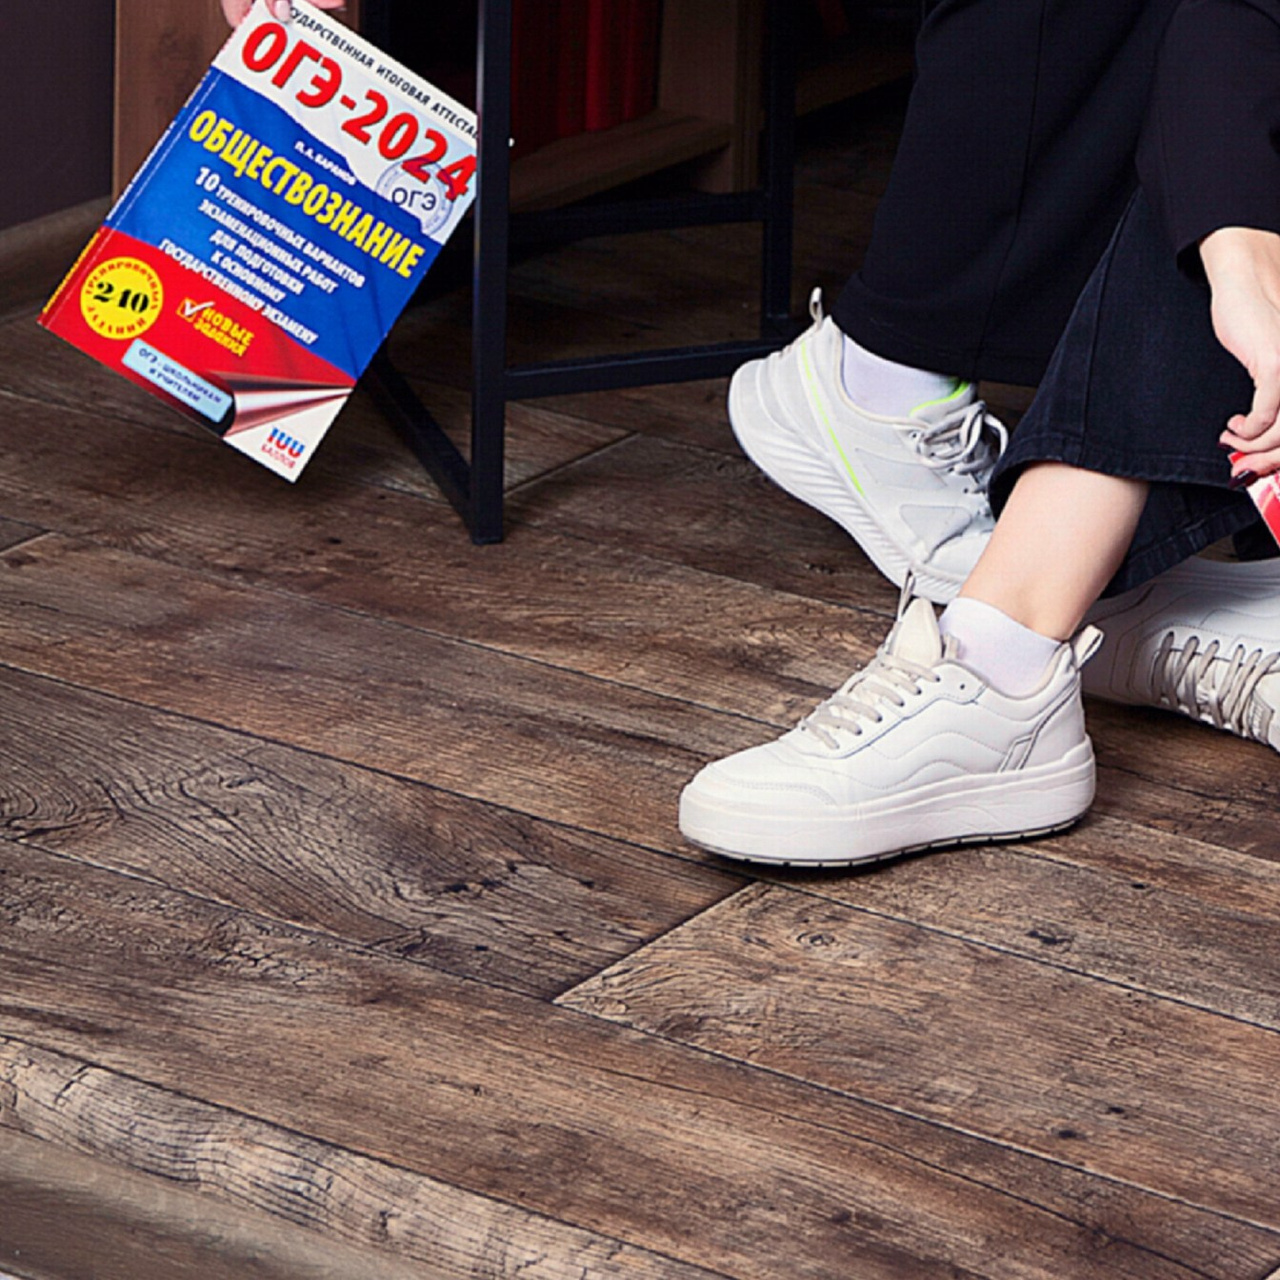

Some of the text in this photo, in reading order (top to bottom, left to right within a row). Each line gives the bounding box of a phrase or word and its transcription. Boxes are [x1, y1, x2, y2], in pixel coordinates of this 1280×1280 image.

[240, 21, 478, 205] ОГЭ-2024
[287, 5, 484, 141] УДАРСТВЕННАЯ ИТОГОВАЯ АТТЕСТА
[188, 109, 425, 278] ОБЩЕСТВОЗНАНИЕ
[195, 166, 365, 287] 10 ТРЕНИРОВОЧНЫХ ВАРИАНТОВ
[389, 186, 437, 221] ОГЭ
[197, 198, 338, 293] ЭКЗАМЕНАЦИОННЫХ РАБОТ
[208, 228, 305, 295] ДЛЯ ПОДГОТОВКИ
[210, 250, 286, 302] К ОСНОВНОМУ
[92, 280, 150, 313] 240
[156, 238, 318, 344] ГОСУДАРСТВЕННОМУ ЭКЗАМЕНУ
[201, 303, 253, 346] НОВЫЕ
[266, 427, 305, 458] 100
